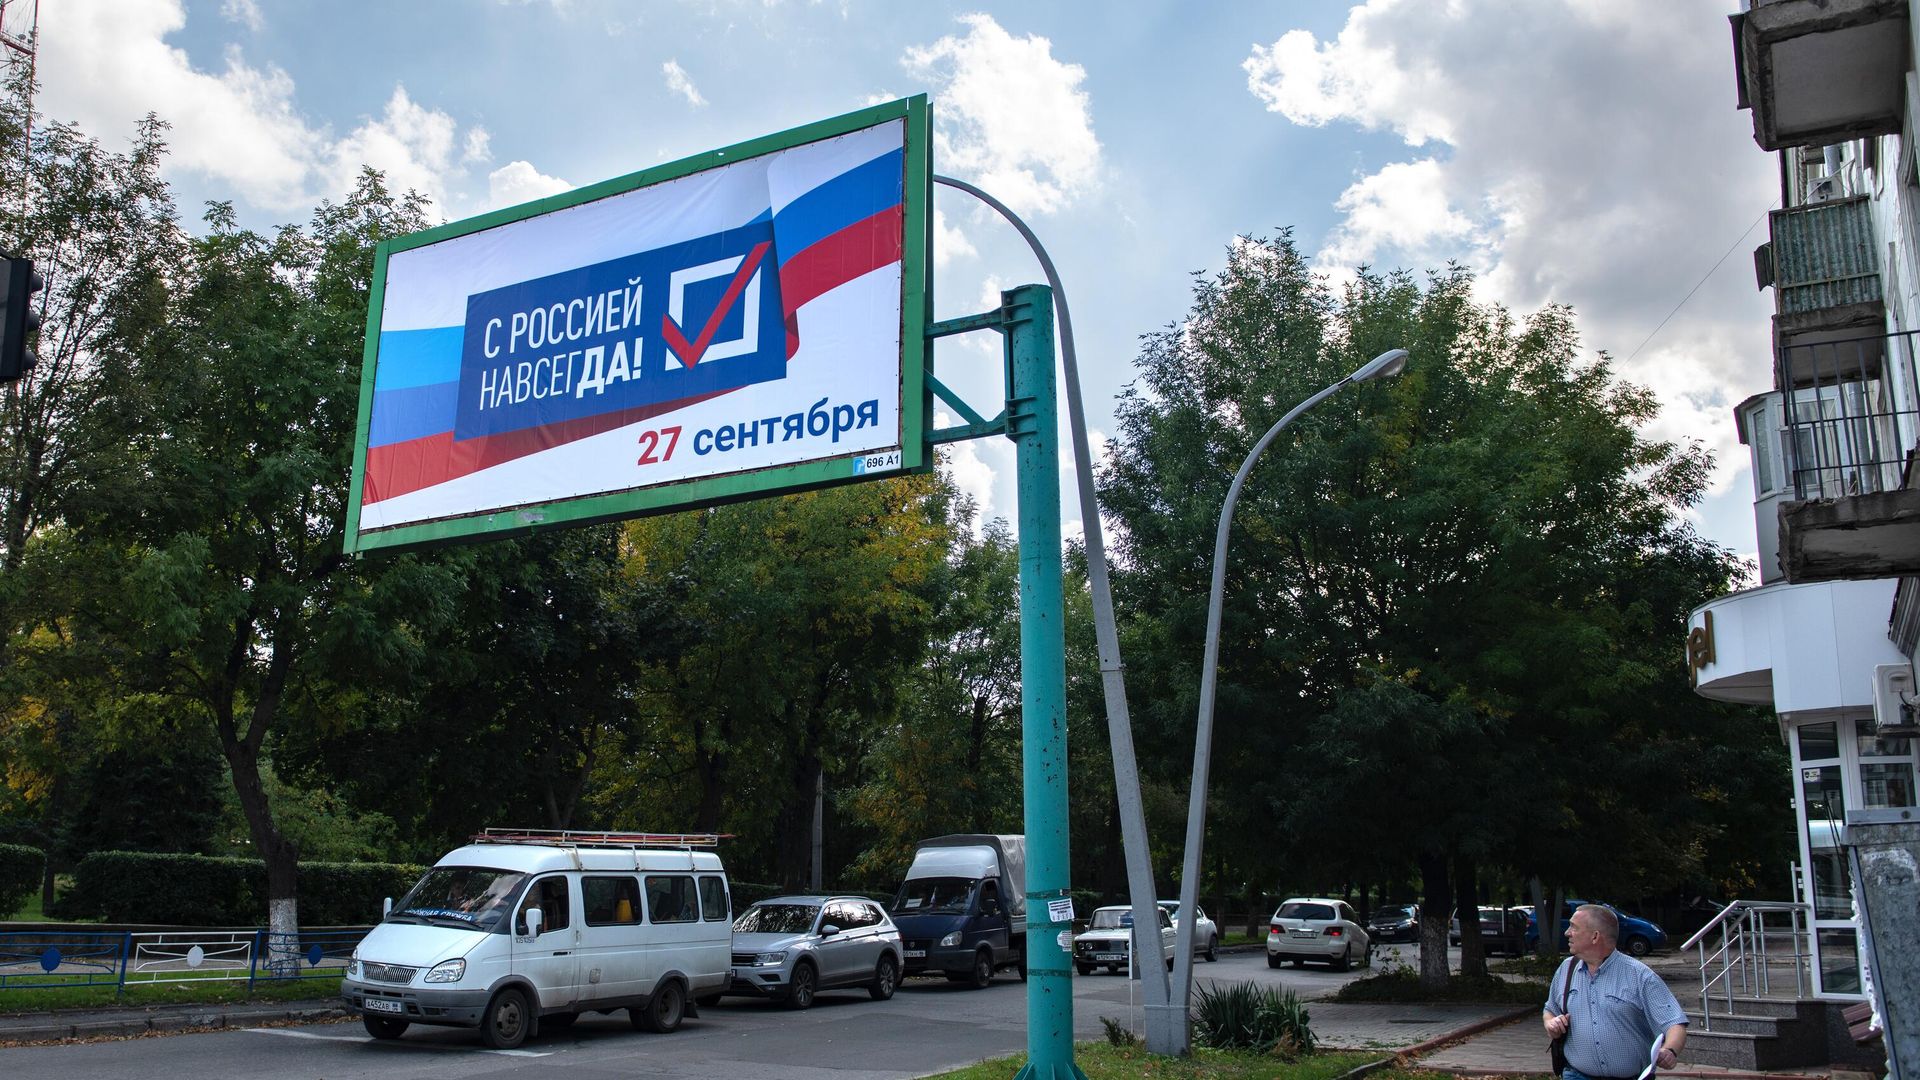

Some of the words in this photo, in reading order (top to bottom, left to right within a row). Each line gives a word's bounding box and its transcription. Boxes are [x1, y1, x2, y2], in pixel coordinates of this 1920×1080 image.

[484, 317, 502, 359] С
[509, 276, 643, 354] РОССИЕЙ
[479, 336, 644, 411] НАВСЕГДА!
[637, 425, 682, 466] 27
[693, 397, 879, 456] сентября
[866, 456, 884, 469] 696
